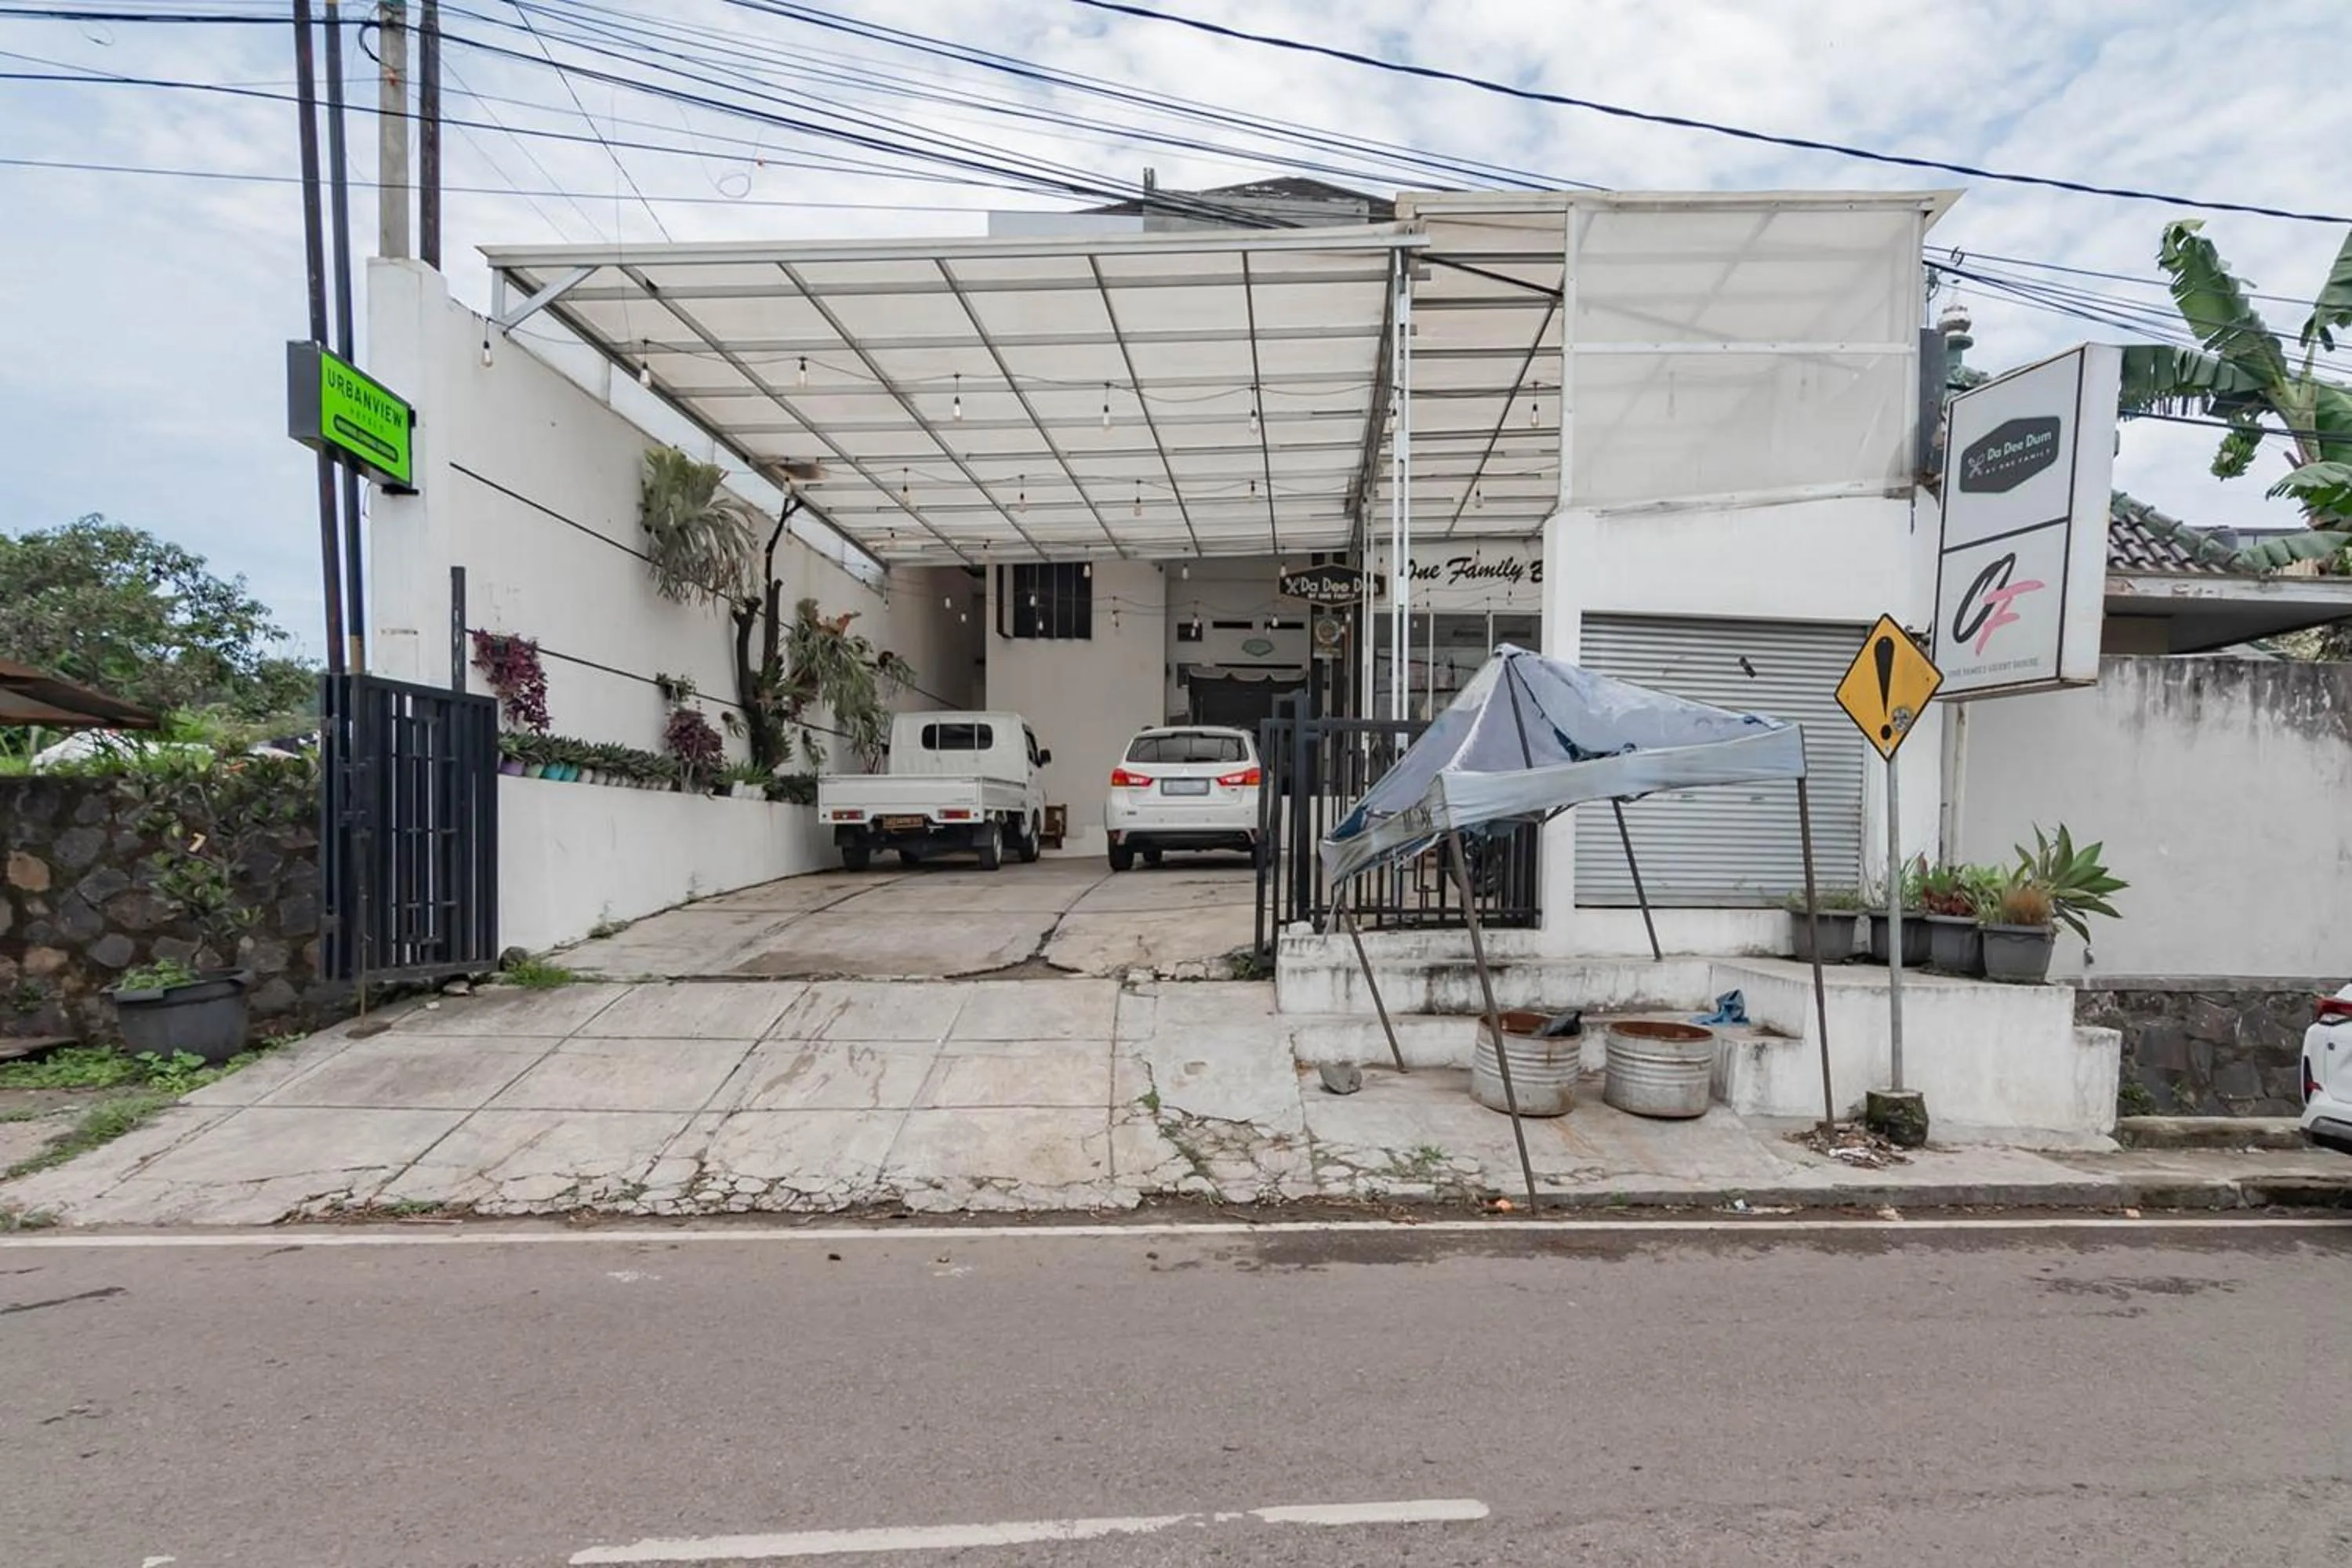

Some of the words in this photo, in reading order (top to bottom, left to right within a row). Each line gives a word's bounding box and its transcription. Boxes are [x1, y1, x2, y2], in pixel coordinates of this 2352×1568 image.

[327, 368, 402, 428] URBANVIEW
[1987, 448, 2002, 461] Da
[2004, 441, 2024, 456] Dee
[2026, 431, 2052, 448] Dum
[1301, 576, 1319, 593] Da
[1322, 576, 1350, 593] Dee
[1446, 557, 1524, 585] Family
